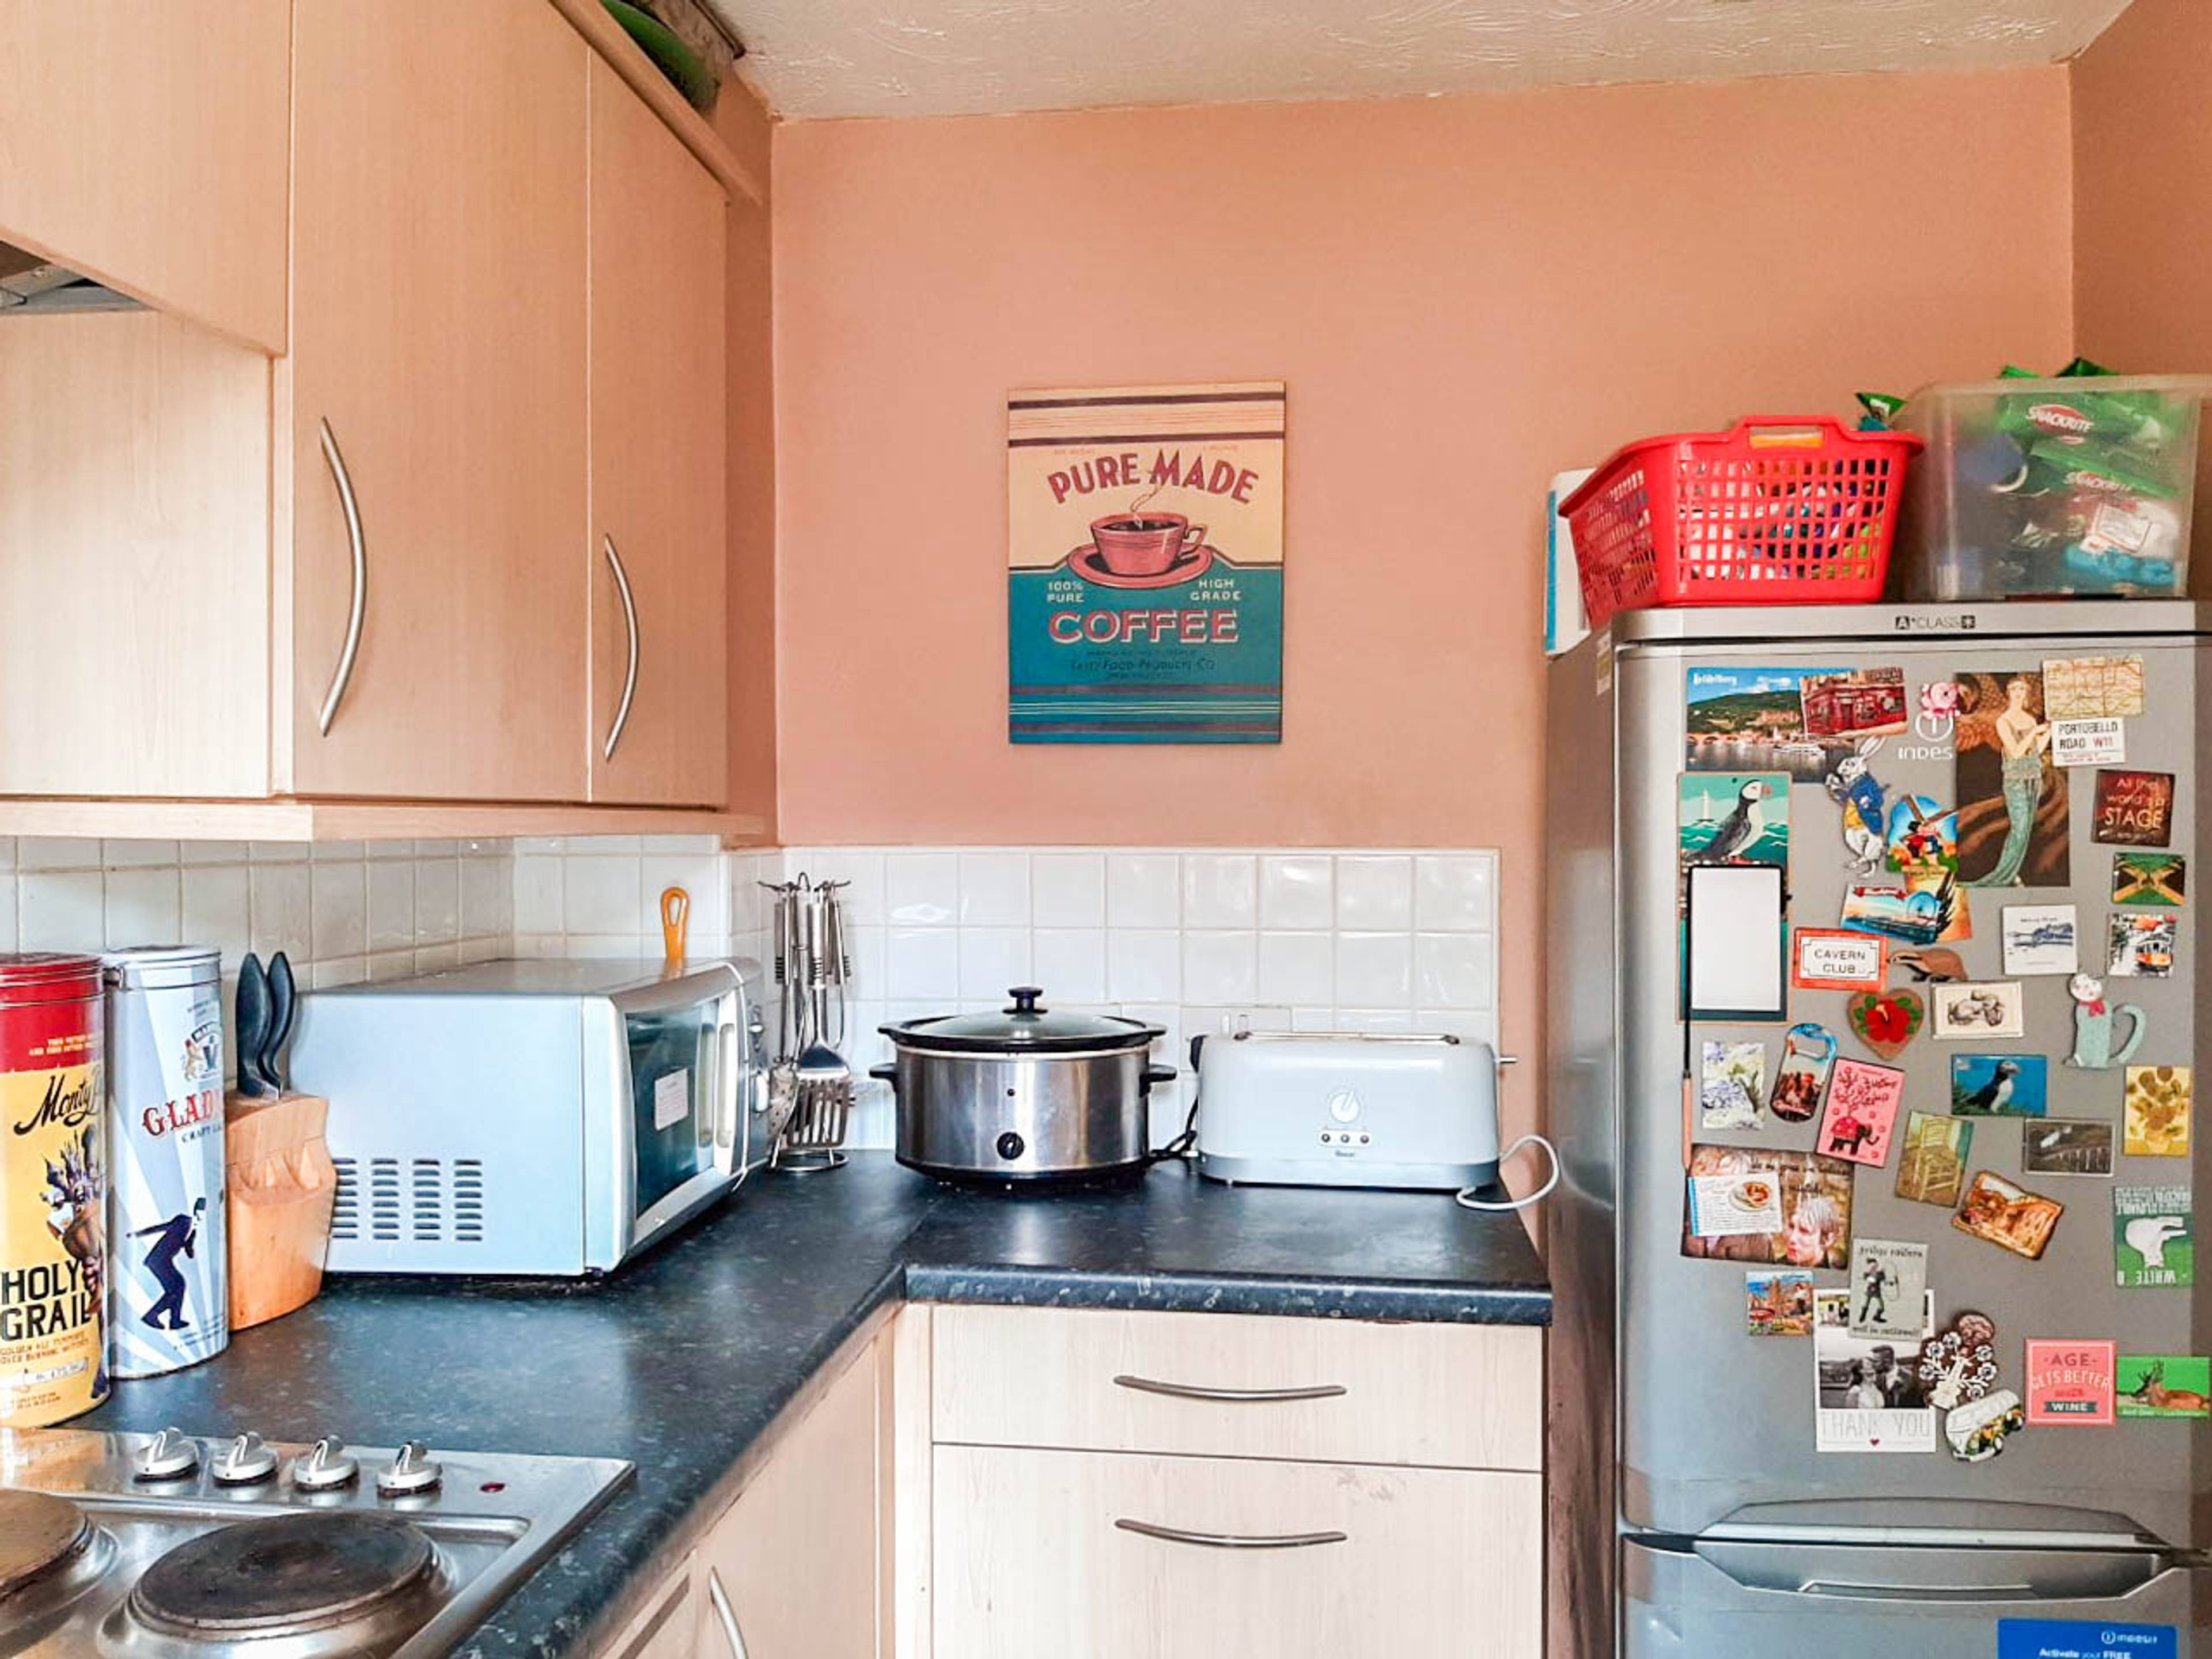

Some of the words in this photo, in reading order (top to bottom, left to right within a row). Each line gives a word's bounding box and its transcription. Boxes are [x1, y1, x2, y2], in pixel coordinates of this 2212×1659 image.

[1047, 453, 1140, 503] PURE
[1149, 449, 1259, 503] MADE
[1048, 581, 1083, 591] 100%
[1199, 579, 1234, 588] HIGH
[1047, 593, 1084, 603] PURE
[1190, 591, 1241, 601] GRADE
[1049, 609, 1238, 643] COFFEE
[2058, 721, 2118, 734] PORTOBELLO
[2060, 738, 2085, 749] ROAD
[2105, 807, 2163, 828] STAGE
[1815, 949, 1866, 960] CAVERN
[1823, 964, 1855, 974] CLUB
[2, 1260, 84, 1305] HOLY
[1, 1292, 92, 1341] GRAIL
[2051, 1353, 2090, 1366] AGE
[2051, 1403, 2088, 1411] WINE
[1820, 1411, 1884, 1438] THANK
[1893, 1411, 1930, 1437] YOU
